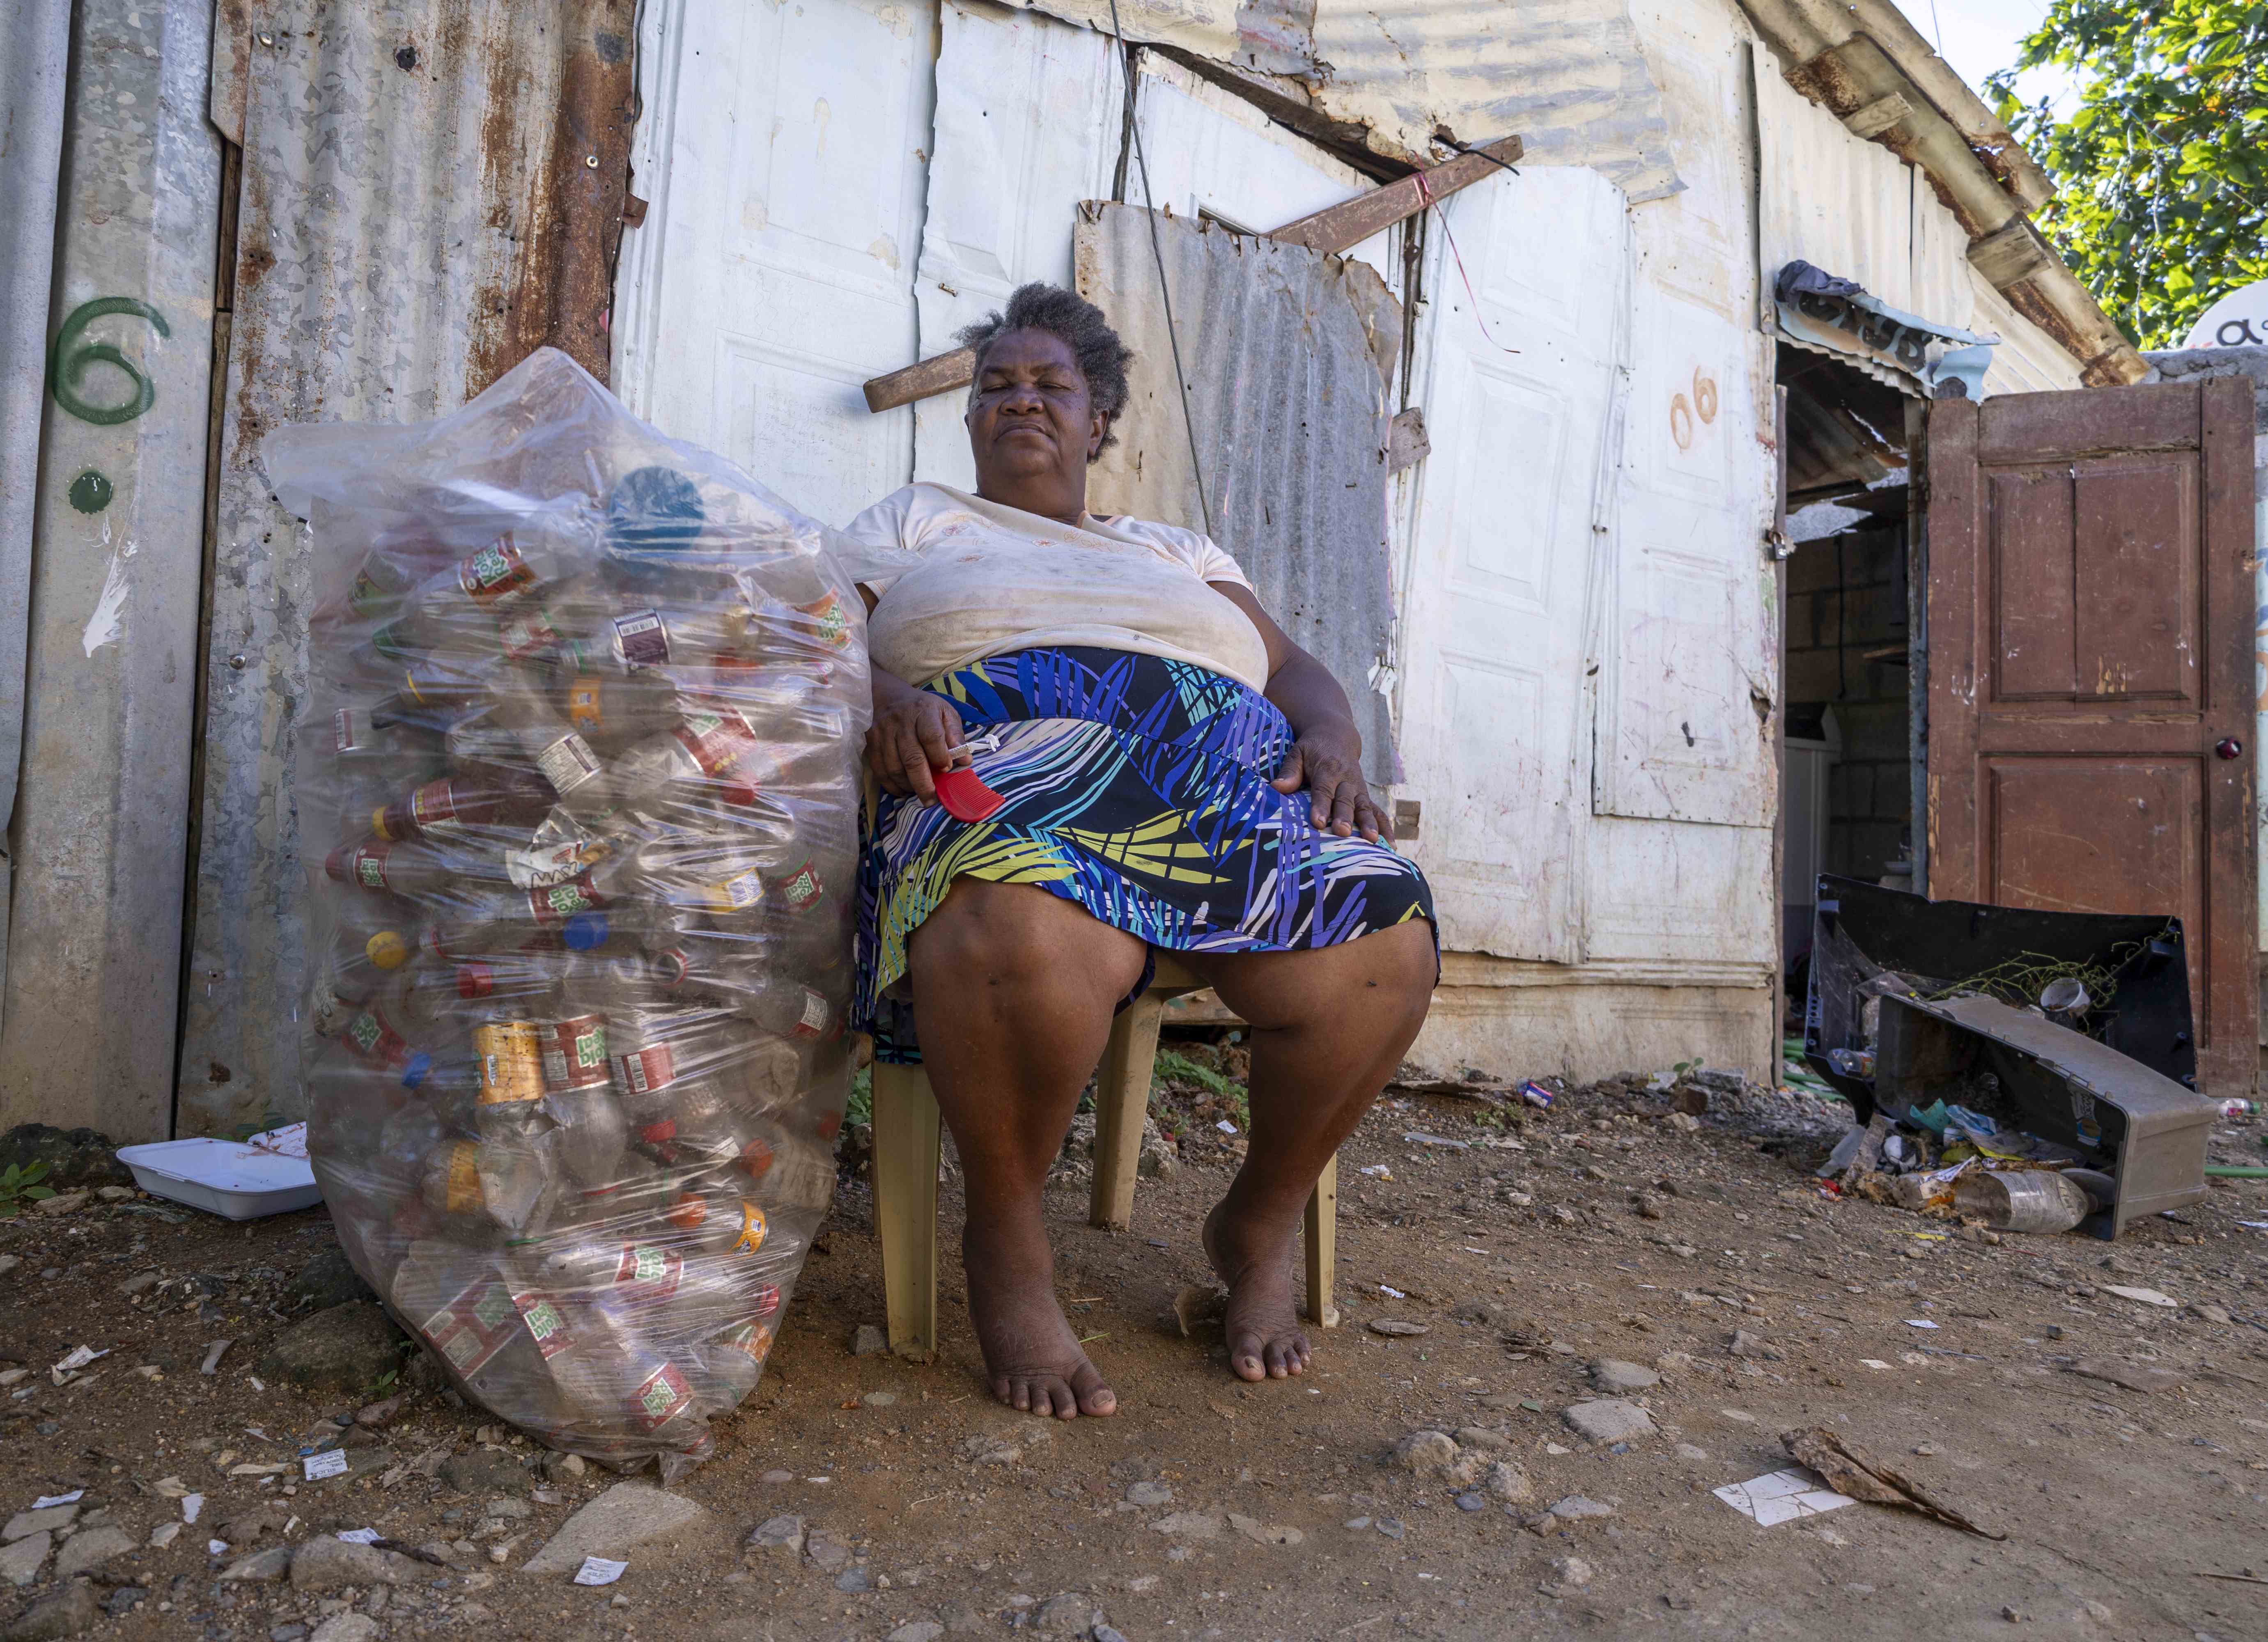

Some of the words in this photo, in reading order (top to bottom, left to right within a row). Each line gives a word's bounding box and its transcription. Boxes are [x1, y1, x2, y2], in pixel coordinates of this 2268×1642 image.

[53, 297, 170, 424] 6
[786, 872, 809, 897] Real
[790, 882, 813, 904] Kola
